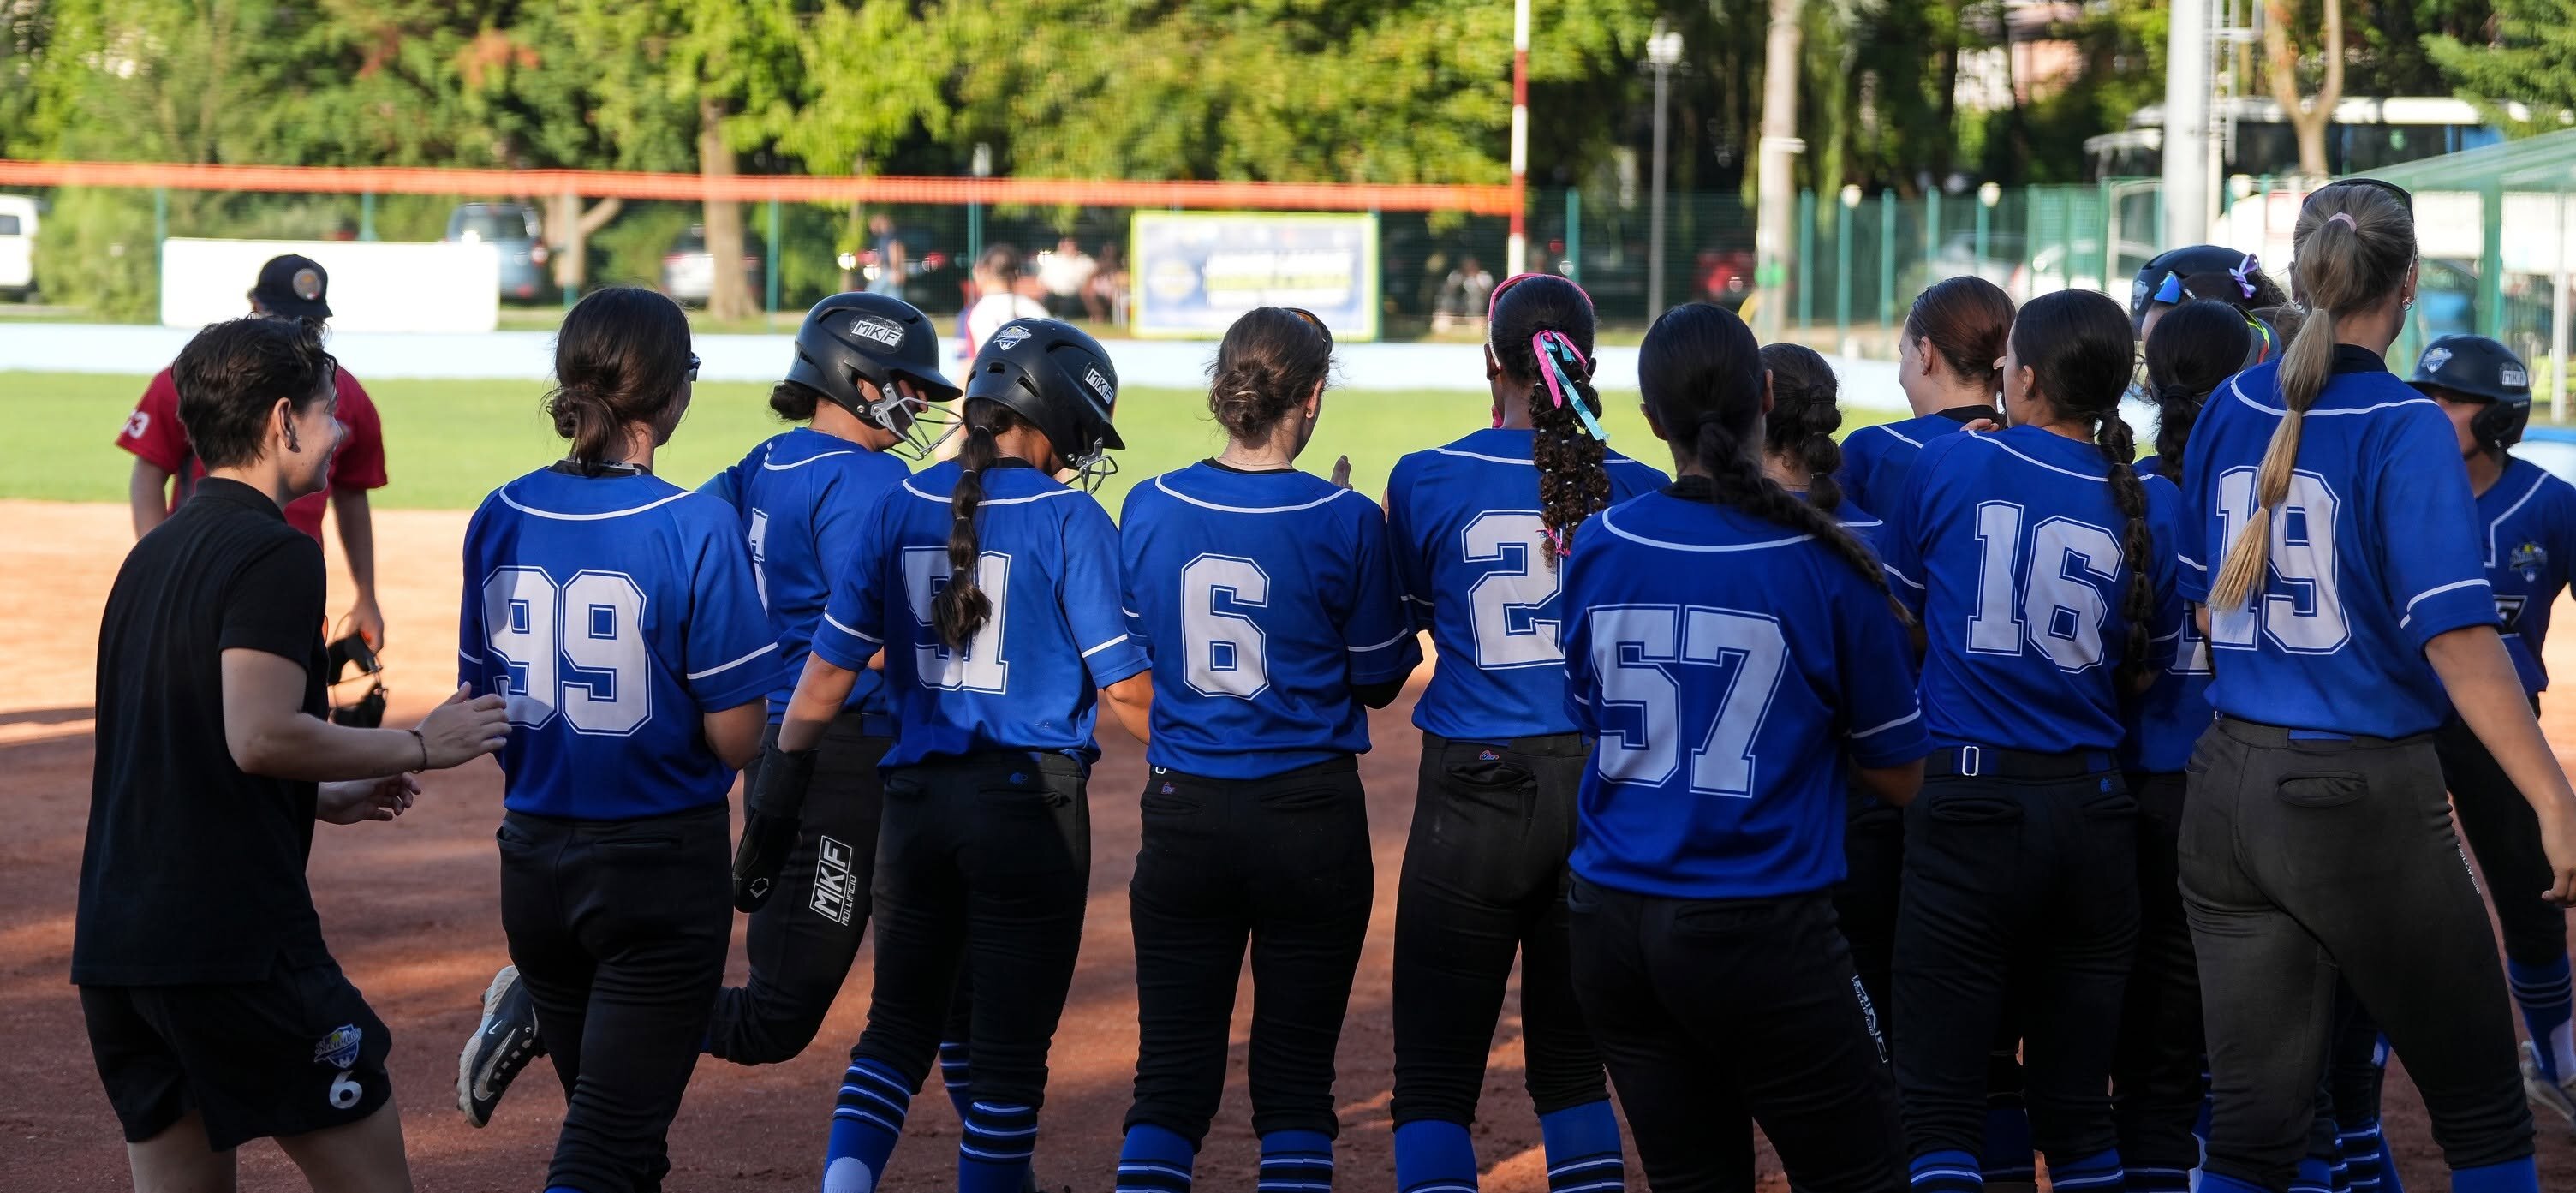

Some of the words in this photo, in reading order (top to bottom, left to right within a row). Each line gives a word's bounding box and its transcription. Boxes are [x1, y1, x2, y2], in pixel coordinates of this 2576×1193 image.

[854, 321, 901, 344] MKF
[1087, 370, 1113, 402] MKF
[1966, 499, 2125, 674] 16
[2209, 466, 2352, 655] 19
[482, 565, 653, 737] 99
[1180, 552, 1271, 701] 6
[1585, 603, 1790, 799] 57
[814, 839, 846, 918] MKF
[841, 874, 857, 927] MOLLIFICIO
[329, 1069, 363, 1109] 6
